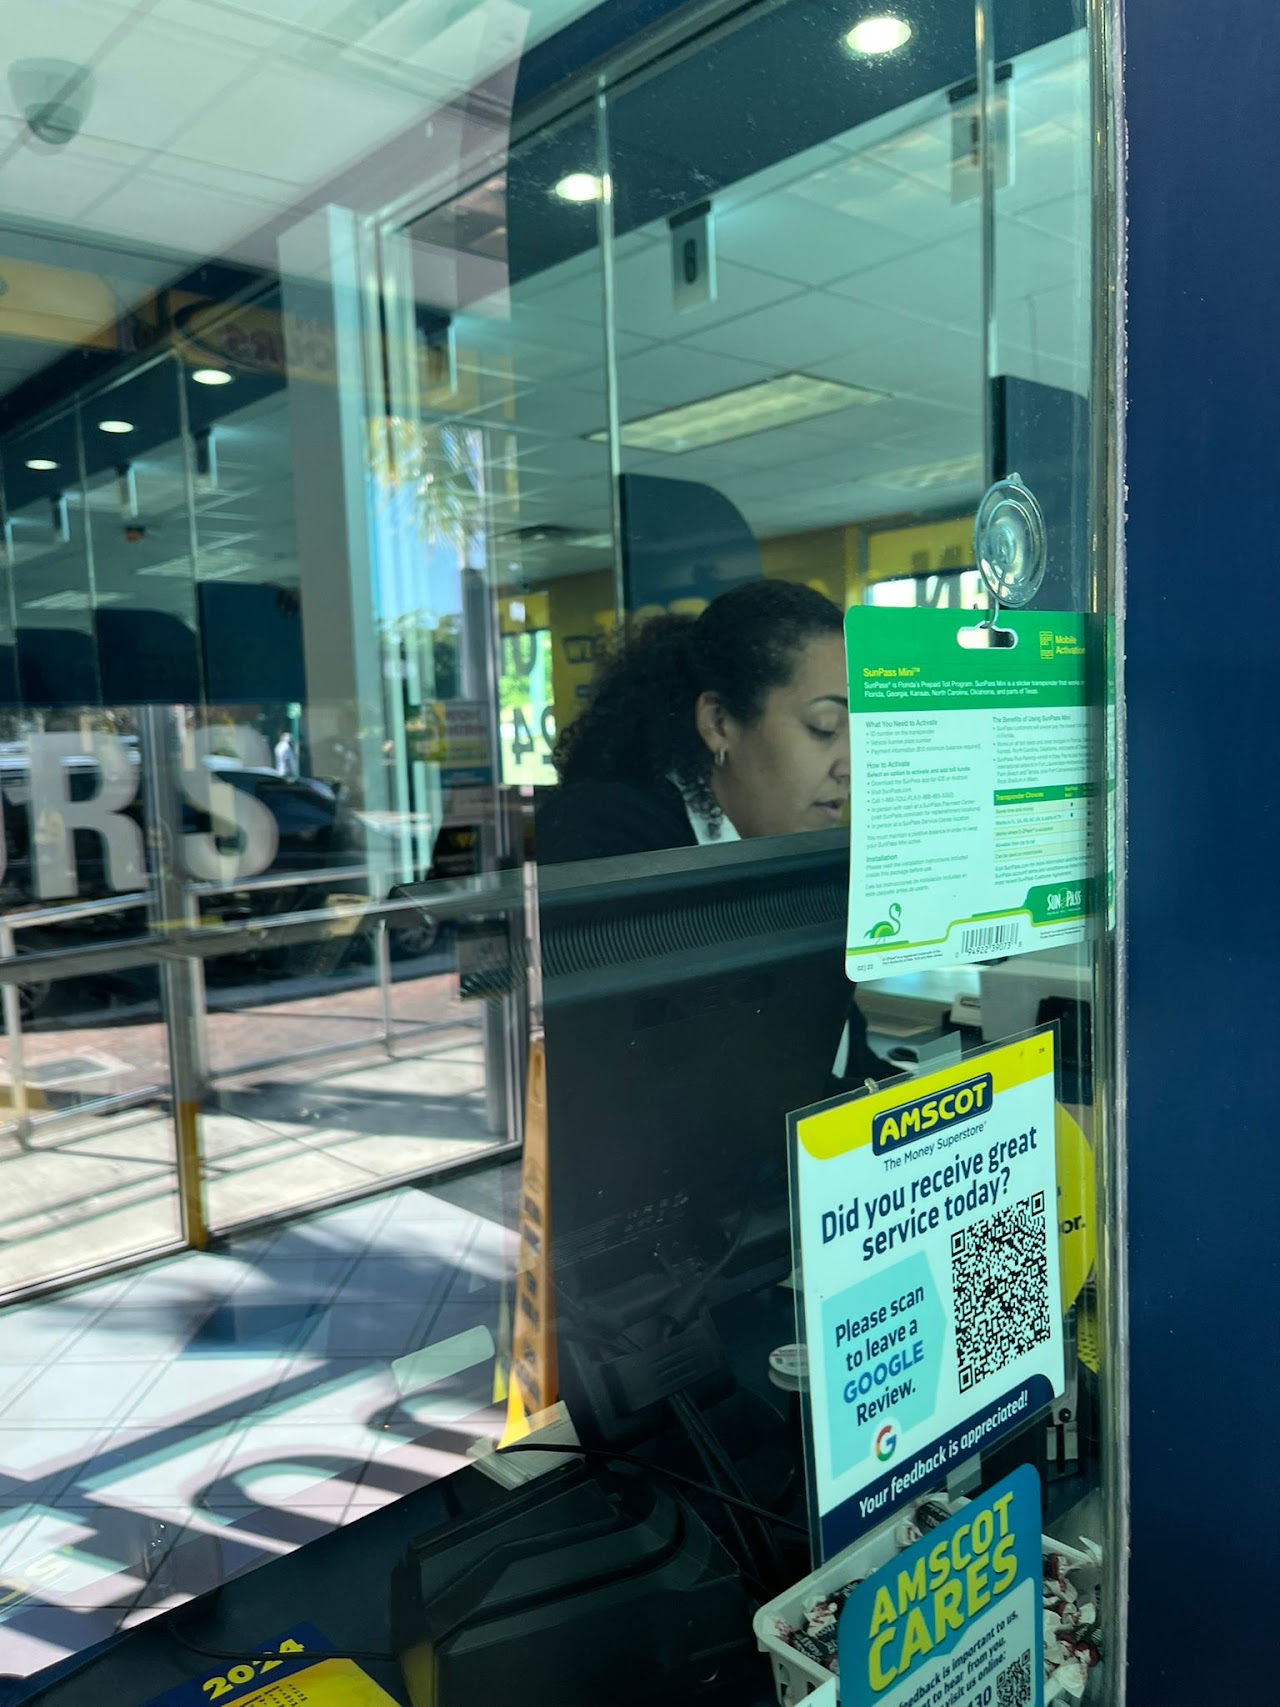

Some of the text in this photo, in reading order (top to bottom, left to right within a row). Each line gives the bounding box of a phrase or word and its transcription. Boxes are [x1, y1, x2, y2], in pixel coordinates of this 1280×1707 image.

[1055, 635, 1077, 645] Mobile
[863, 667, 897, 678] SunPass
[865, 718, 938, 728] What You Need to Activate
[866, 761, 879, 769] How
[887, 760, 910, 768] Activate
[866, 853, 898, 863] Installation
[1066, 890, 1081, 908] PASS
[879, 1081, 988, 1146] AMSCOT
[884, 1157, 902, 1171] The
[904, 1143, 935, 1164] Money
[822, 1126, 1037, 1245] Did you receive great
[863, 1166, 1010, 1261] service today?
[1058, 1215, 1086, 1234] or.
[835, 1286, 924, 1348] Please scan
[846, 1319, 918, 1372] to leave a
[843, 1340, 924, 1404] GOOGLE
[857, 1378, 916, 1427] Review.
[859, 1488, 889, 1518] Your
[890, 1445, 947, 1501] feedback
[949, 1439, 958, 1459] is
[960, 1390, 1028, 1450] appreciated!
[869, 1491, 1013, 1639] AMSCOT
[868, 1533, 1018, 1693] CARES
[933, 1690, 942, 1703] to
[944, 1671, 964, 1694] hear
[967, 1654, 988, 1674] from
[988, 1637, 1006, 1658] you.
[942, 1666, 950, 1679] is
[952, 1627, 995, 1671] important
[996, 1621, 1005, 1634] to
[966, 1677, 977, 1692] us
[977, 1651, 1006, 1681] online:
[967, 1685, 992, 1707] 30
